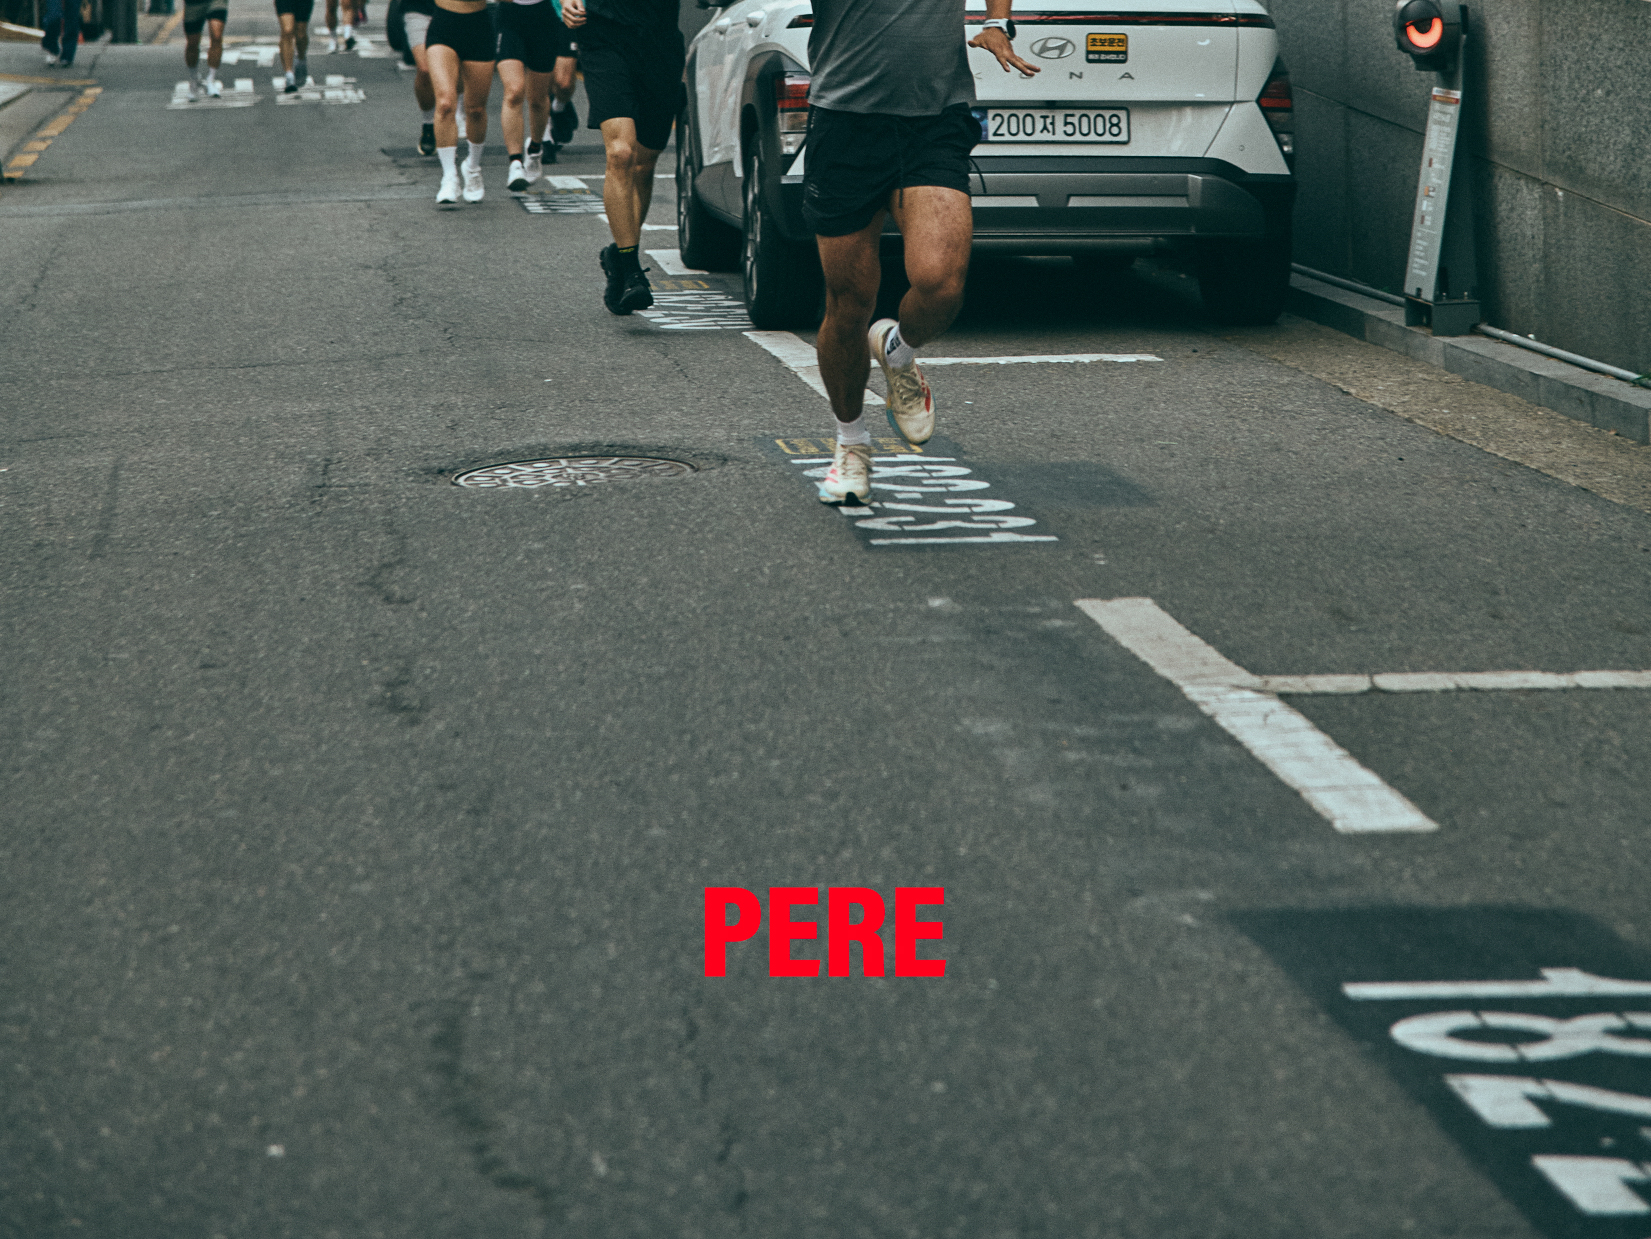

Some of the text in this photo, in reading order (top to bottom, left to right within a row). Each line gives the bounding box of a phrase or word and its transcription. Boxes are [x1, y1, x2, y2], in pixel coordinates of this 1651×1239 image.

[1089, 37, 1125, 47] 초보운전
[992, 113, 1122, 137] 200저 5008
